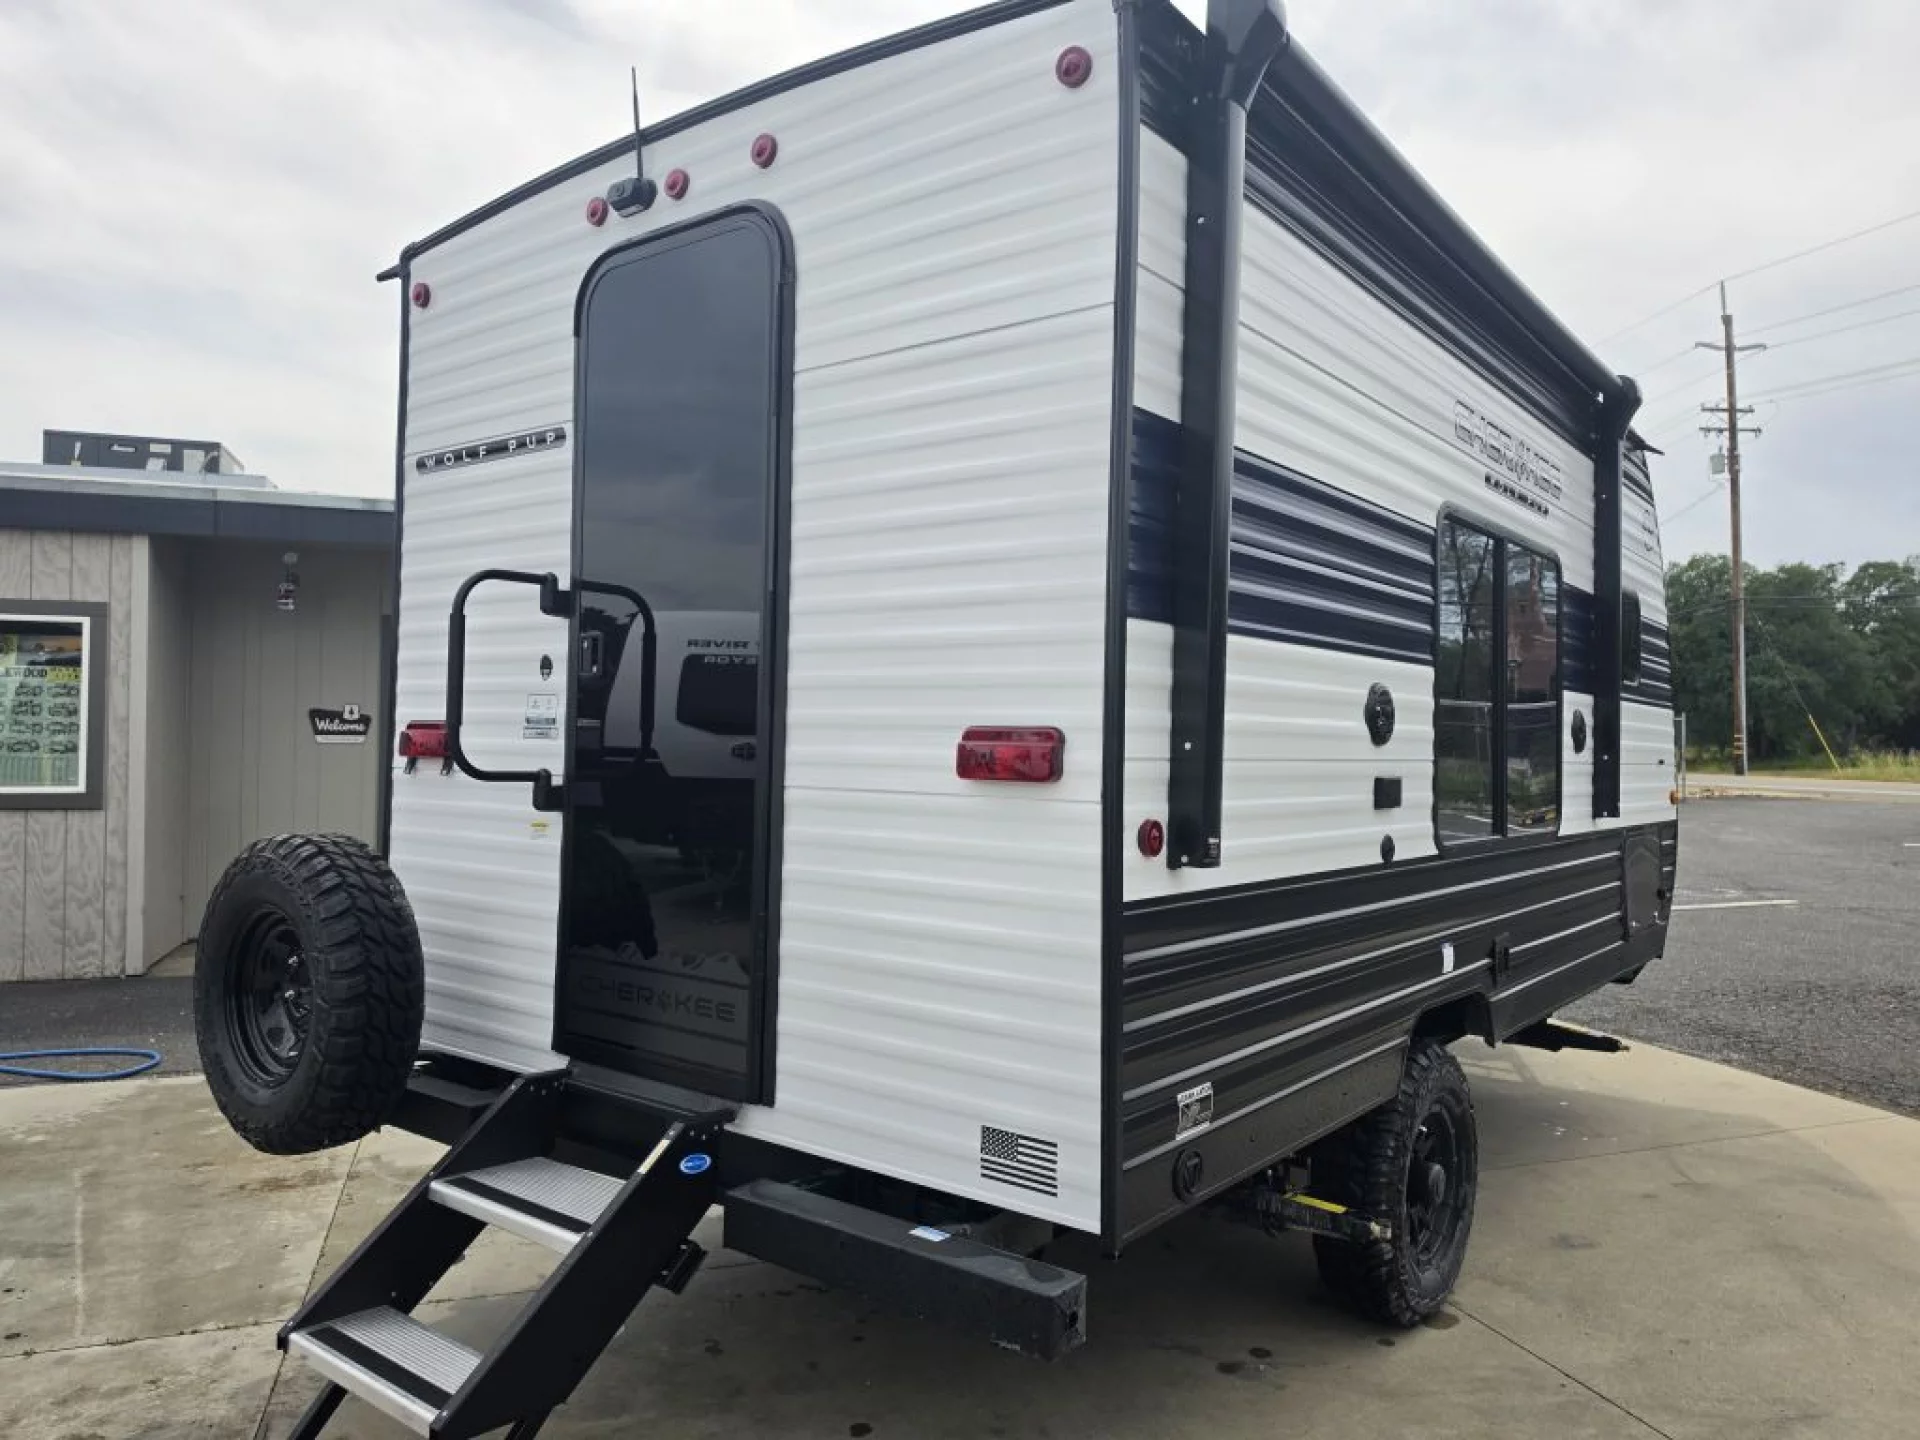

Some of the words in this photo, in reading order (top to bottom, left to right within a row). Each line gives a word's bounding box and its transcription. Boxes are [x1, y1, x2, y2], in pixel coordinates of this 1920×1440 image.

[423, 445, 488, 470] WOLF
[507, 431, 556, 454] PUP
[314, 716, 366, 732] Welcome
[579, 974, 736, 1023] CHEROKEE
